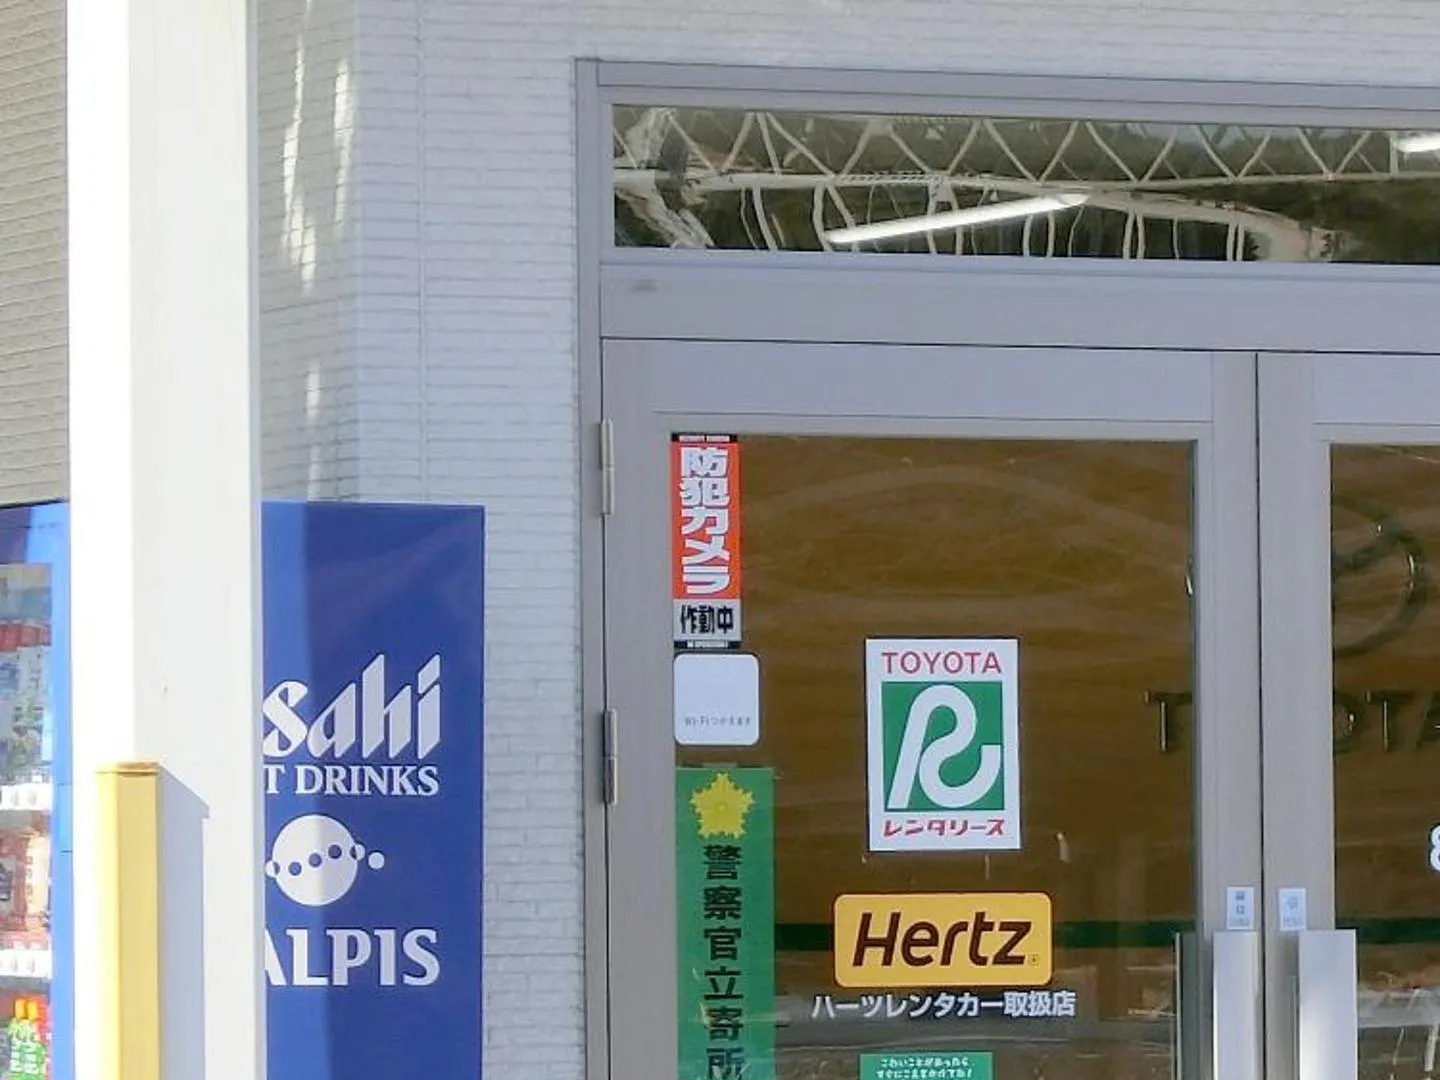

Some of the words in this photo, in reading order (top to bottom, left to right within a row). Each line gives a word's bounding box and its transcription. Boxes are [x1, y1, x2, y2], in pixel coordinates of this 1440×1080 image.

[679, 447, 728, 595] 防犯カメラ
[680, 605, 734, 635] 作動中
[881, 651, 1002, 675] TOYOTA
[262, 652, 440, 758] sahi
[295, 764, 440, 797] DRINKS
[883, 819, 1004, 838] レンタリース
[851, 911, 1032, 968] Hertz
[264, 928, 441, 987] ALPIS
[812, 991, 1076, 1018] ハーツレンタカー取扱店
